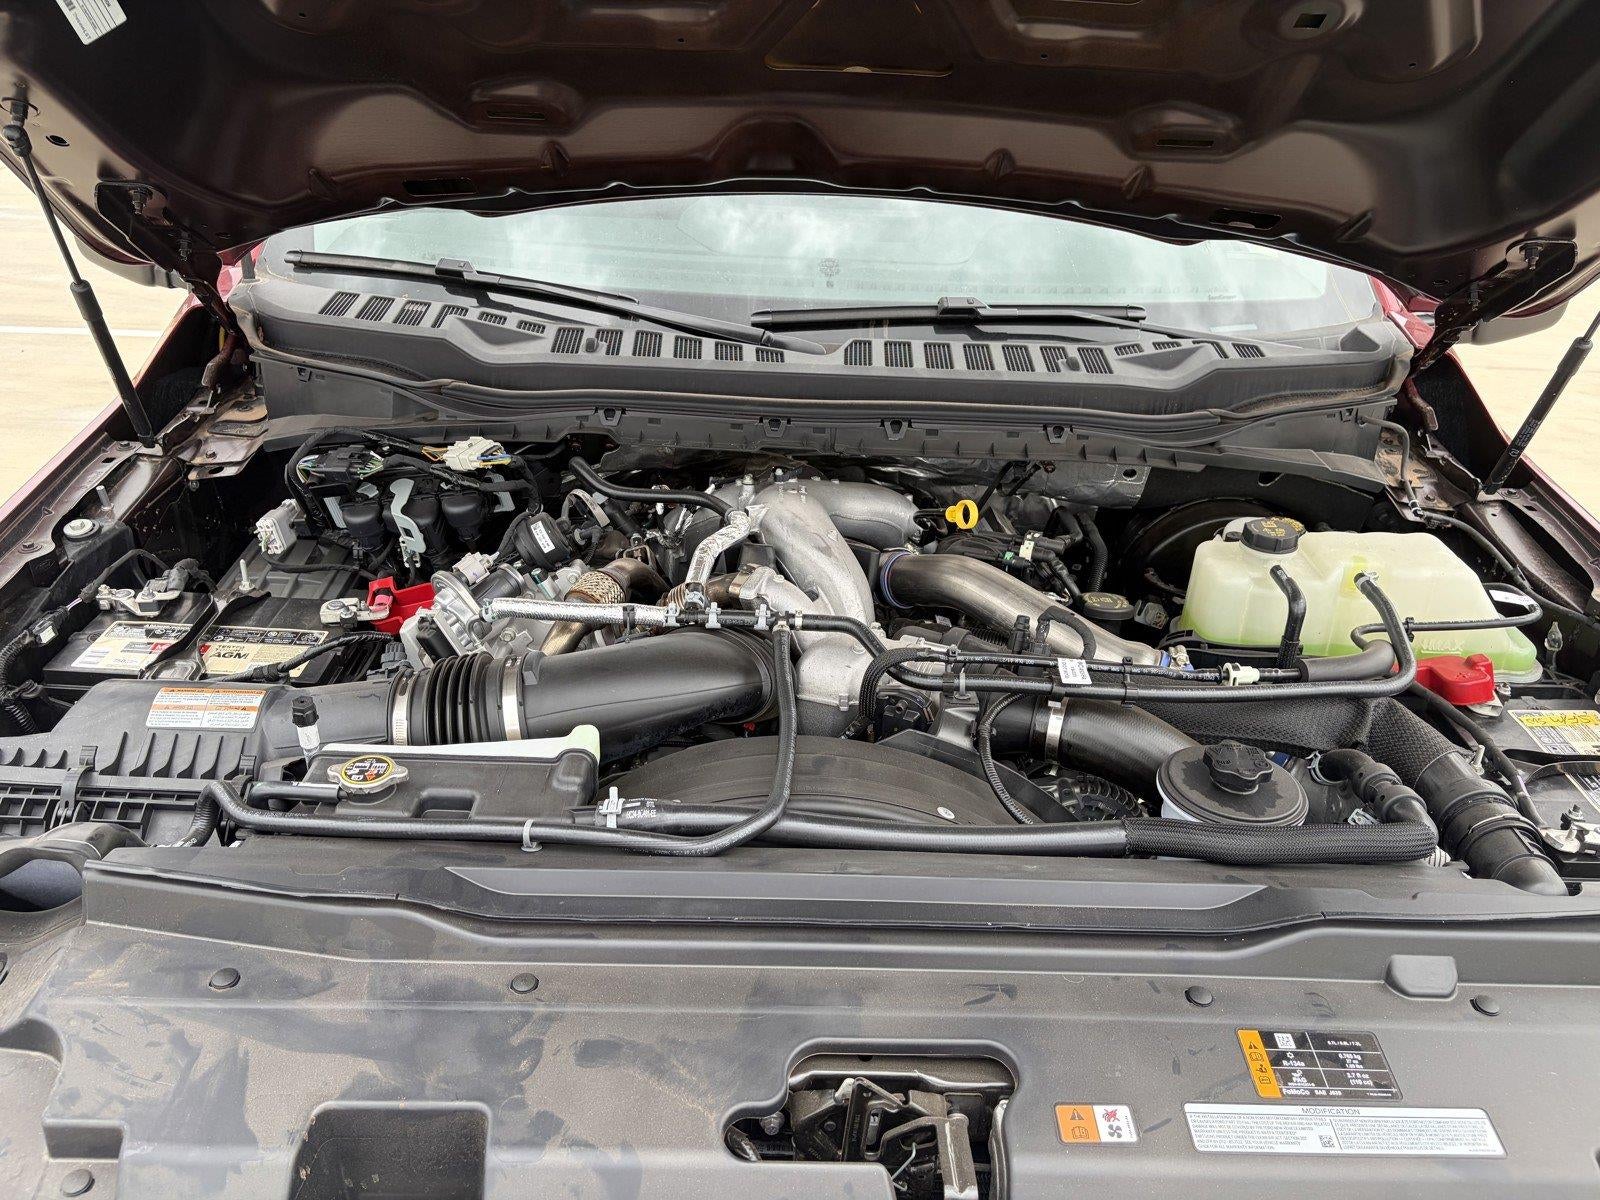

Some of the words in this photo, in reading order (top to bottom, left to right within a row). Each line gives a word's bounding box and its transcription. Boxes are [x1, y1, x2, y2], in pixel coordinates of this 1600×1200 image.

[209, 651, 249, 660] AGM
[1282, 1088, 1311, 1096] FoMoCo
[1301, 1107, 1361, 1115] MODIFICATION
